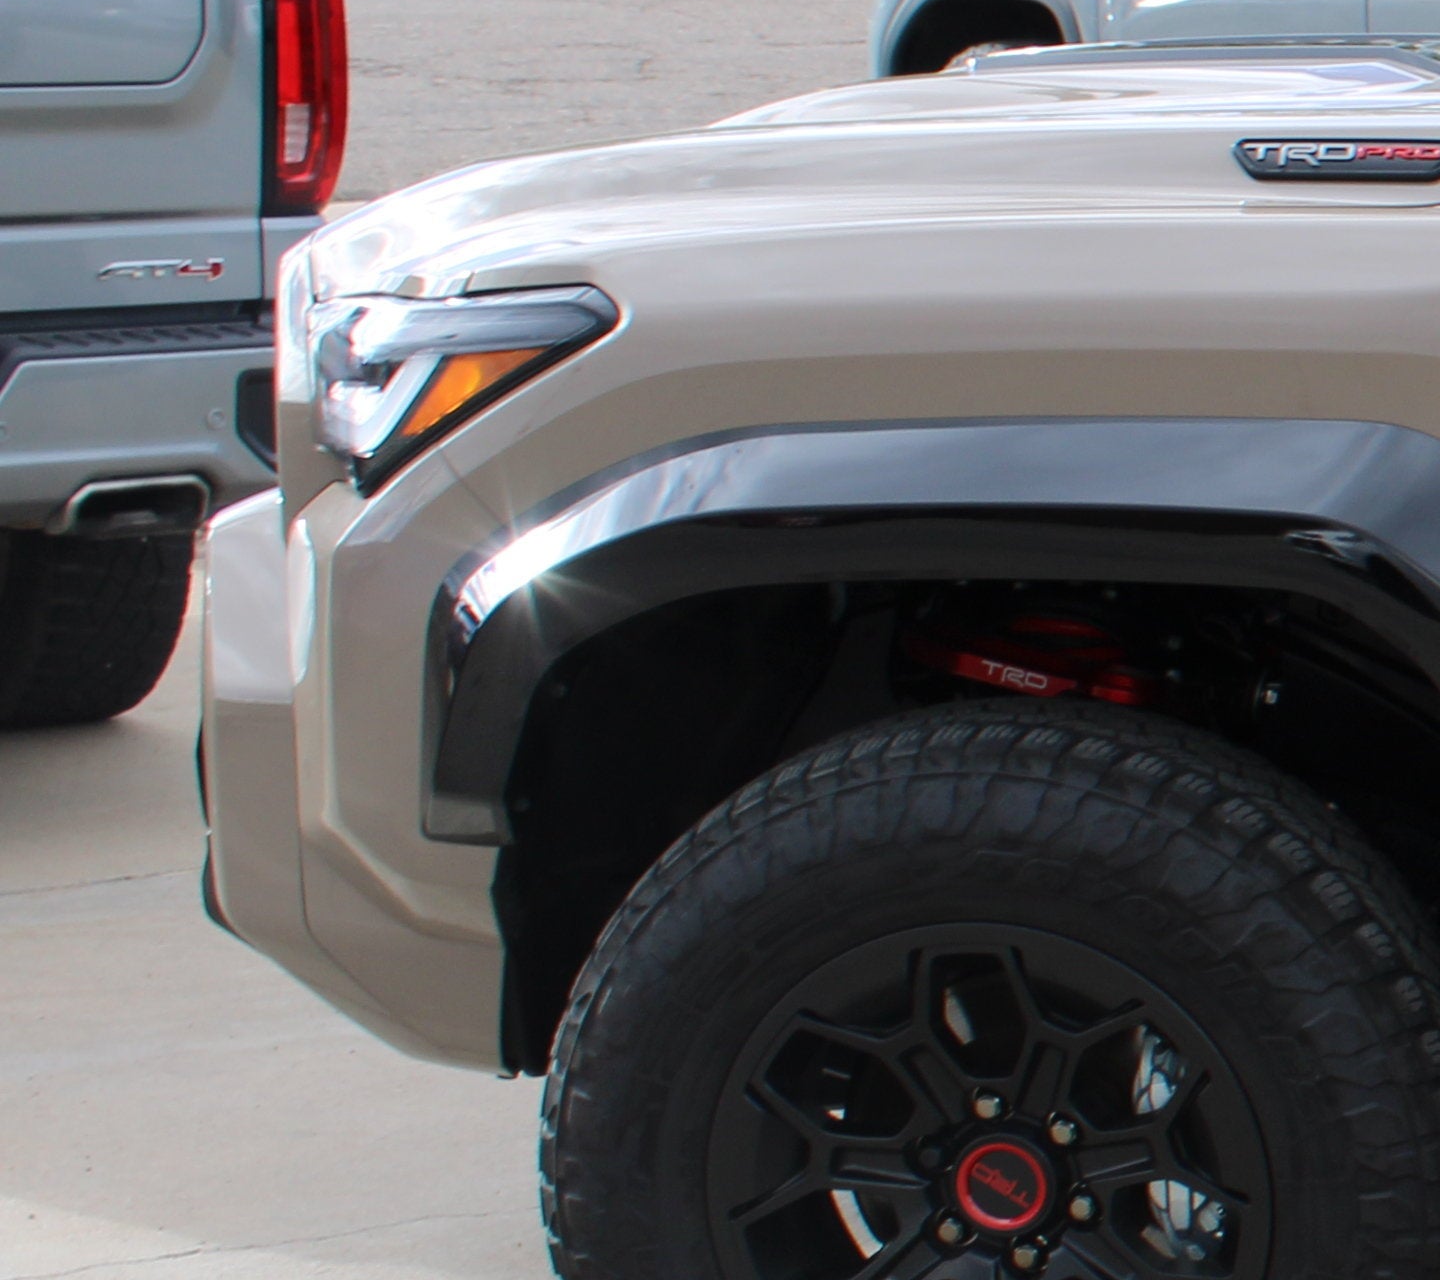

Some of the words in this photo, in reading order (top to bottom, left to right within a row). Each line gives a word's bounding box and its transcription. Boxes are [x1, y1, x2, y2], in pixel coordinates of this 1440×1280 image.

[1244, 141, 1356, 168] TRD
[97, 257, 225, 282] AT4
[981, 658, 1048, 690] TRD
[971, 1161, 1034, 1210] TRD
